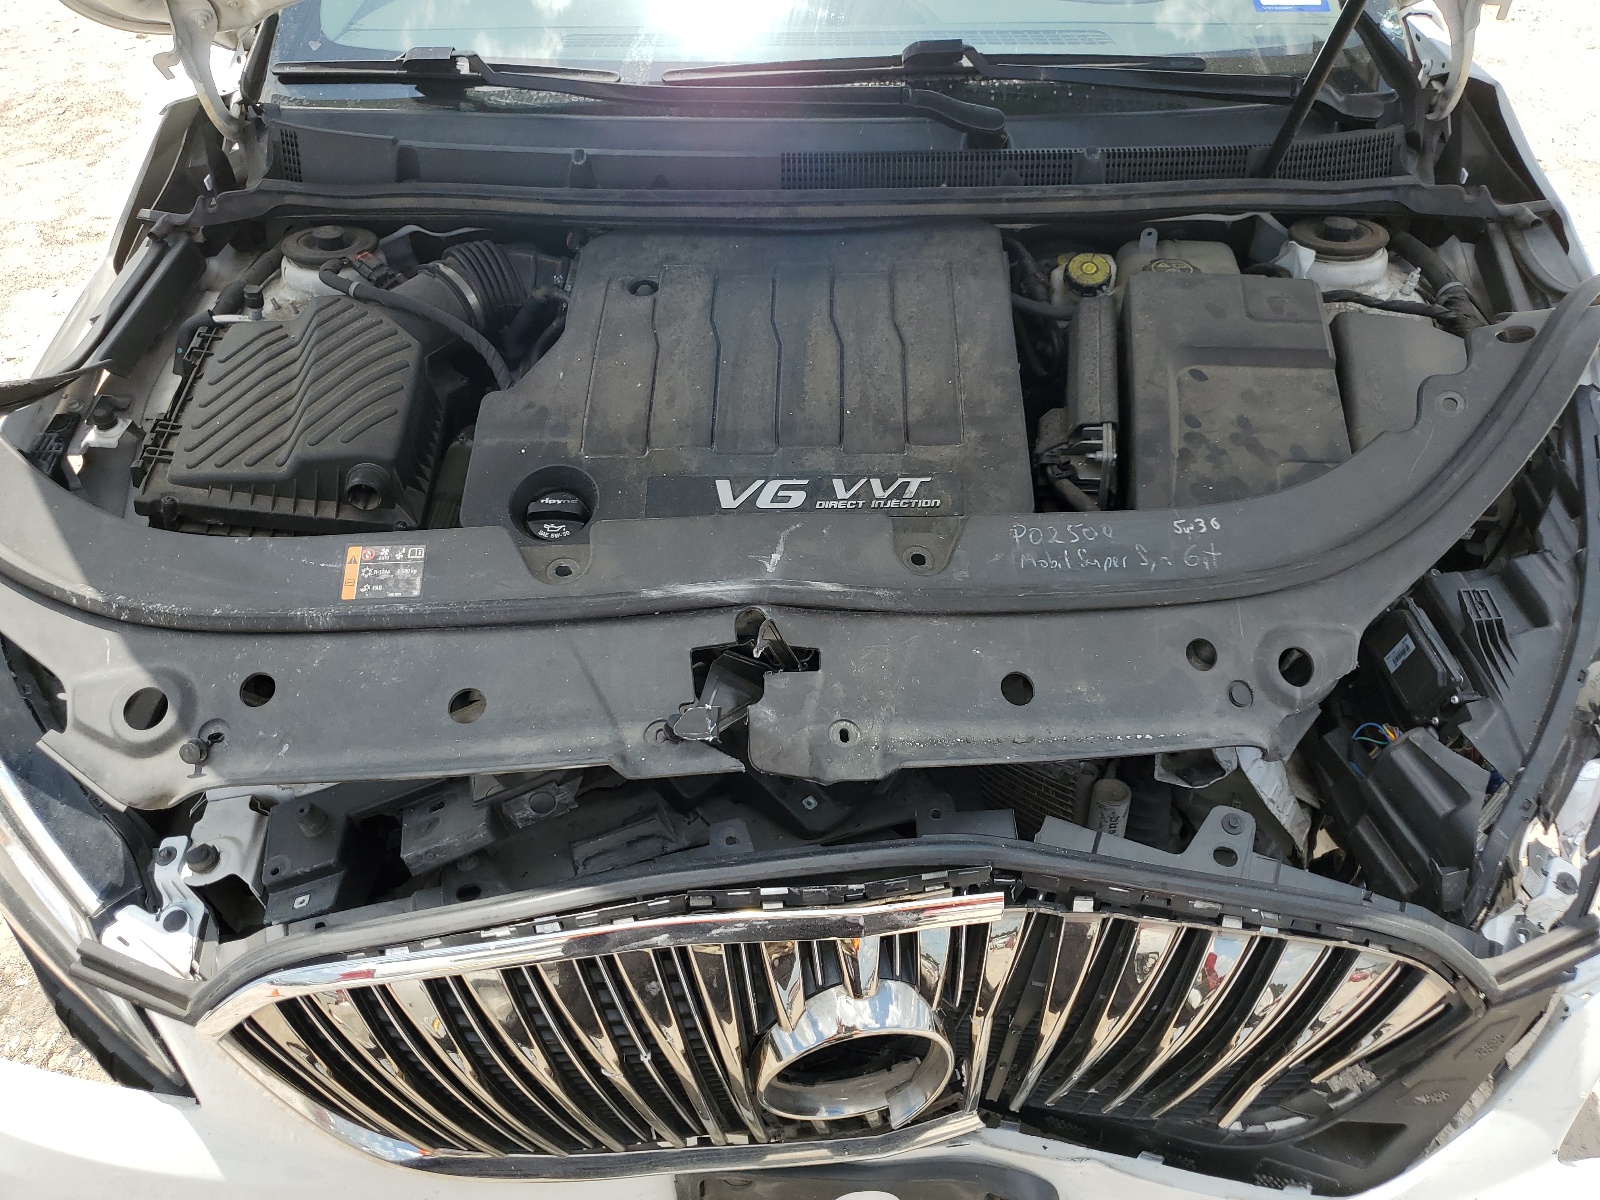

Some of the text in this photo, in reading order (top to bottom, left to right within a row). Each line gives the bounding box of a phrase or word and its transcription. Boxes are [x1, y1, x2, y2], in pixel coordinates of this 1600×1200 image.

[715, 477, 933, 509] V6 VVT
[815, 499, 942, 510] DIRECT INJECTION
